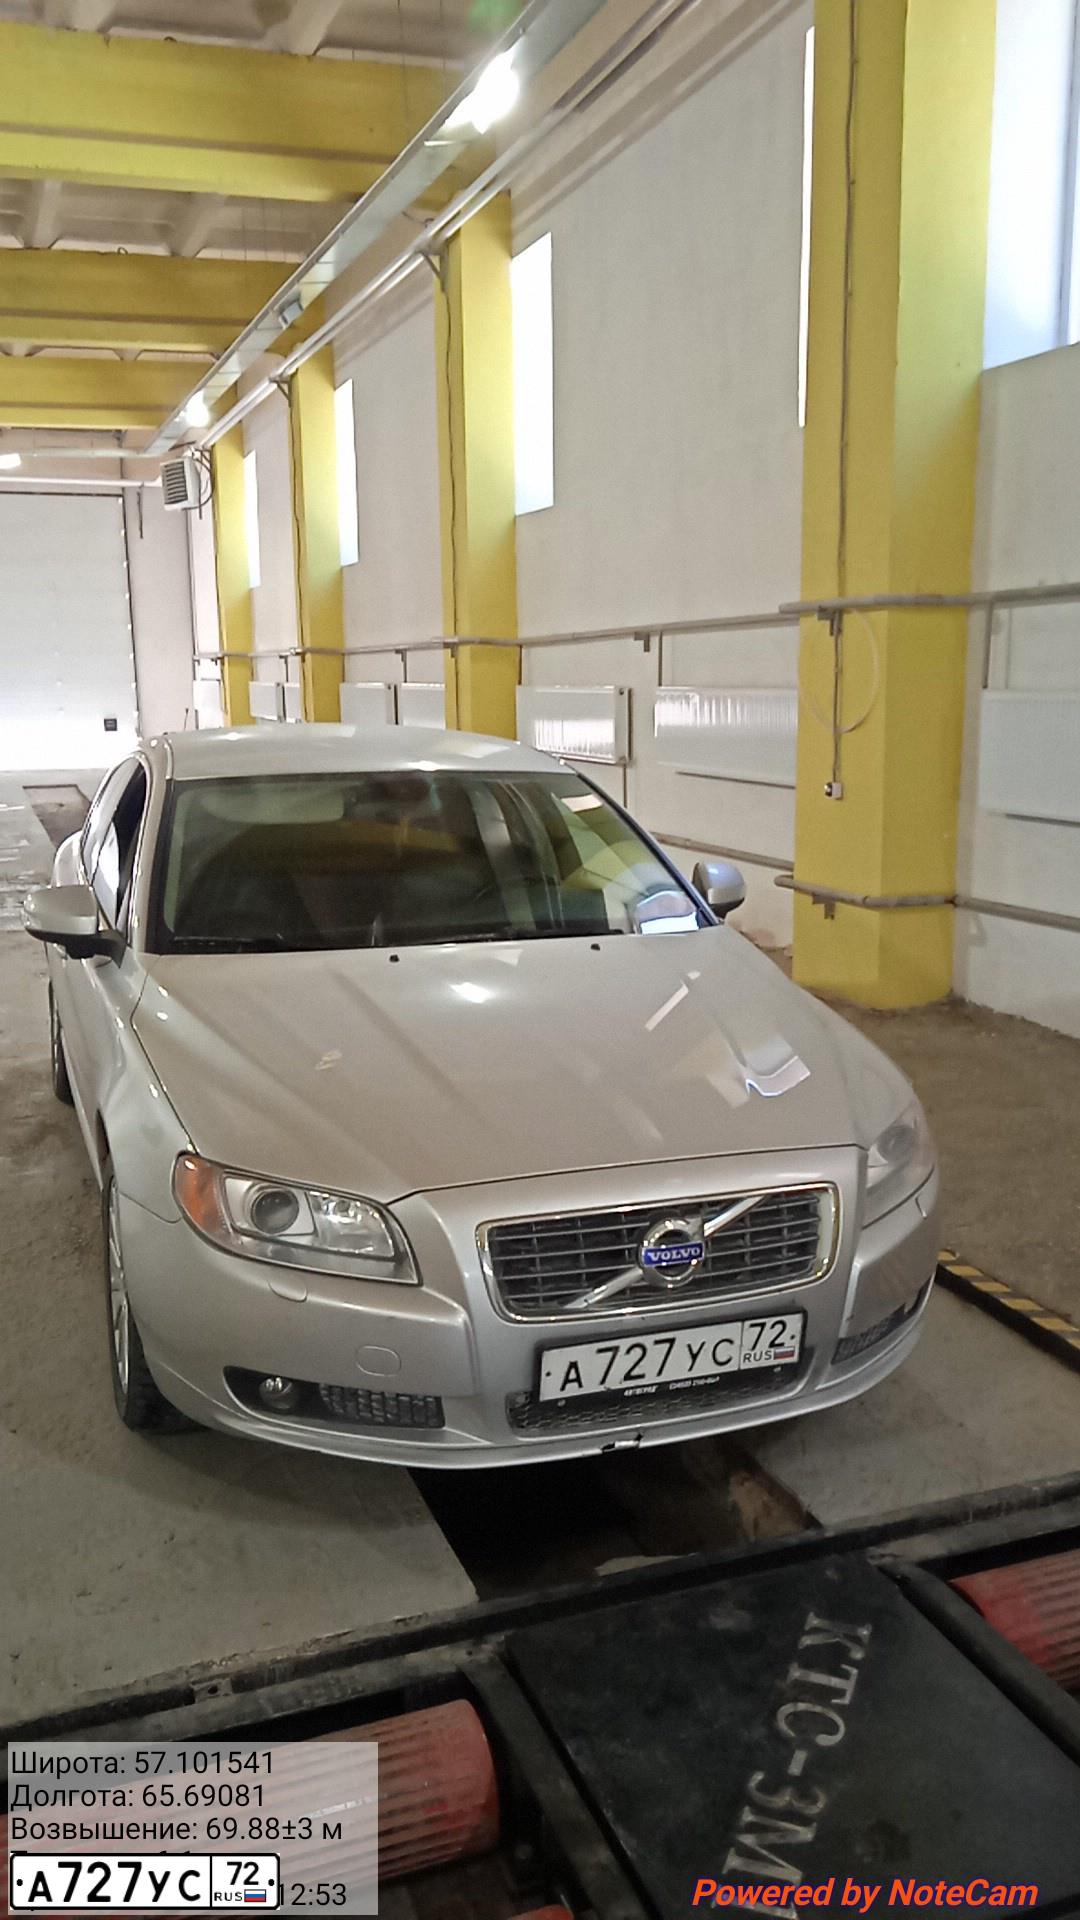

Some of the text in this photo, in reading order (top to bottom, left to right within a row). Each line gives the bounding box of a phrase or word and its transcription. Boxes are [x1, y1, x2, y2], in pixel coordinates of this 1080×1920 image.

[647, 1247, 700, 1262] VOLVO
[560, 1320, 788, 1391] А727УС 72
[742, 1350, 773, 1363] RUS
